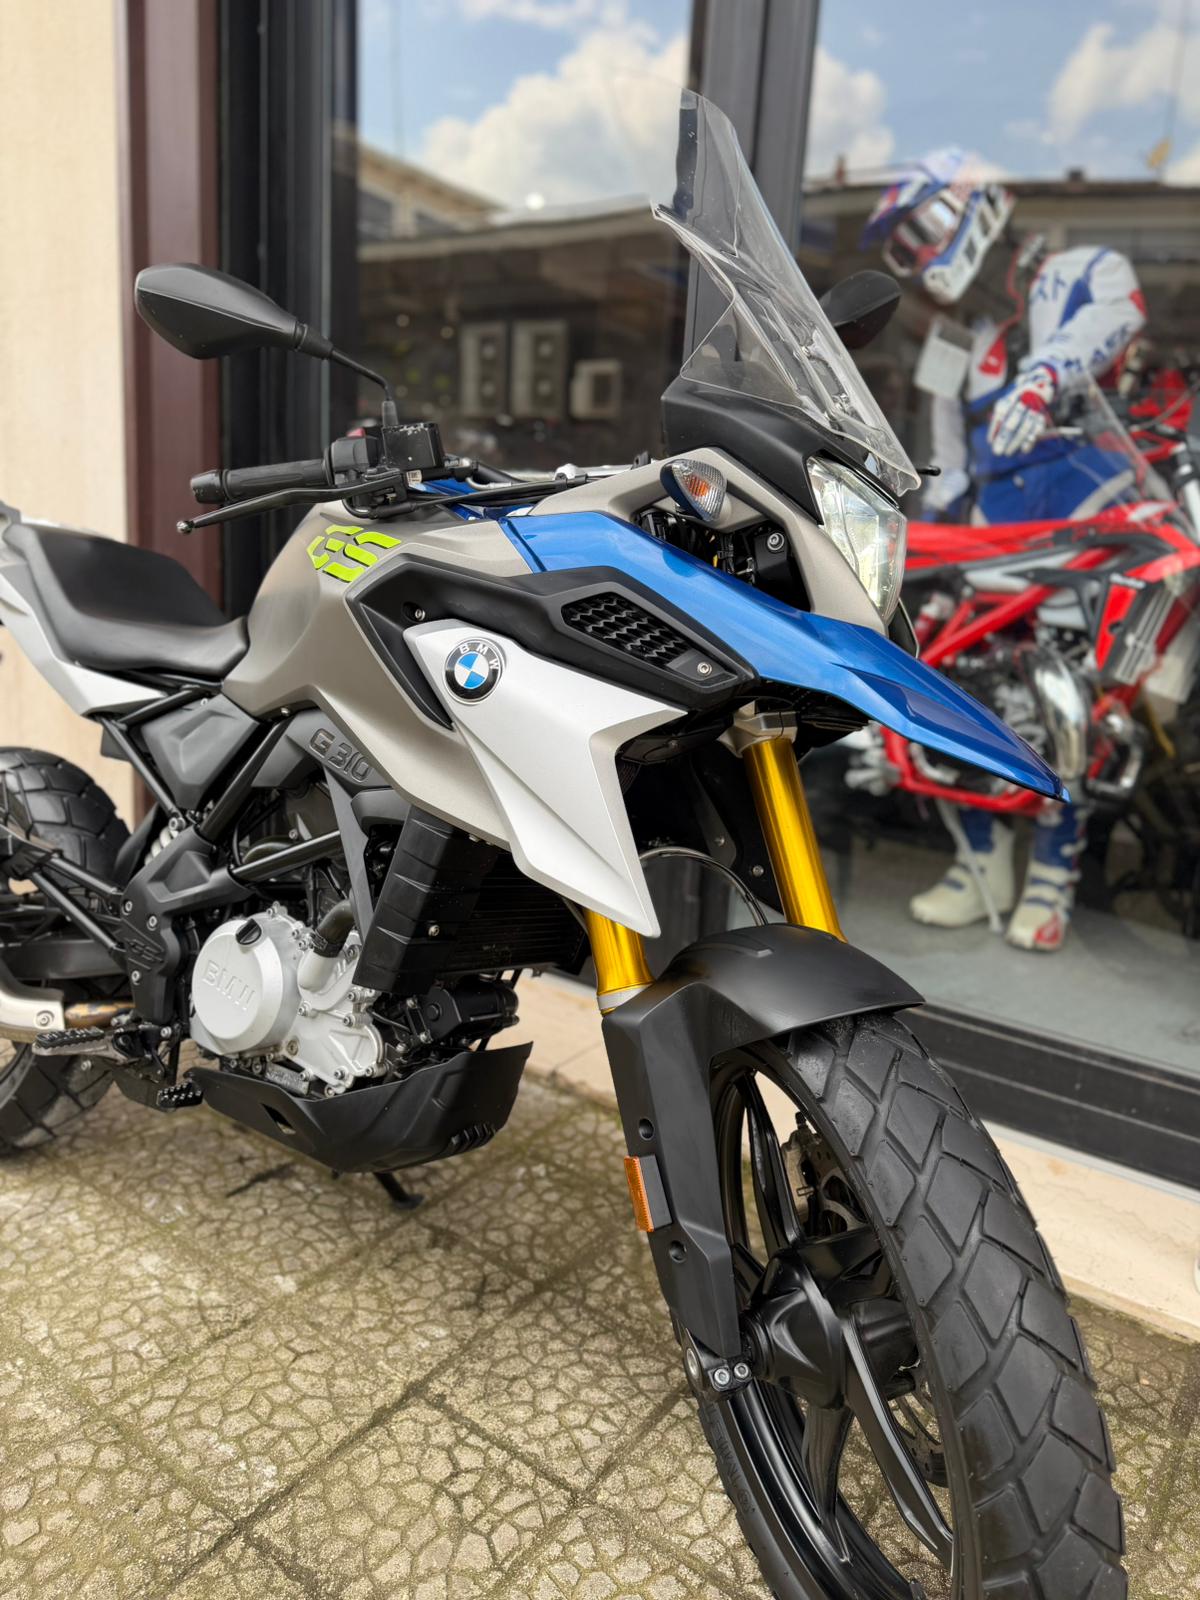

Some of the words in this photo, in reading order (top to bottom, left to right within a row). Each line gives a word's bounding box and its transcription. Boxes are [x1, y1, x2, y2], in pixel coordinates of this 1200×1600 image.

[307, 524, 402, 583] GS
[459, 643, 500, 670] BMW
[309, 727, 336, 759] G
[328, 742, 373, 783] 310
[202, 959, 256, 1011] BMW
